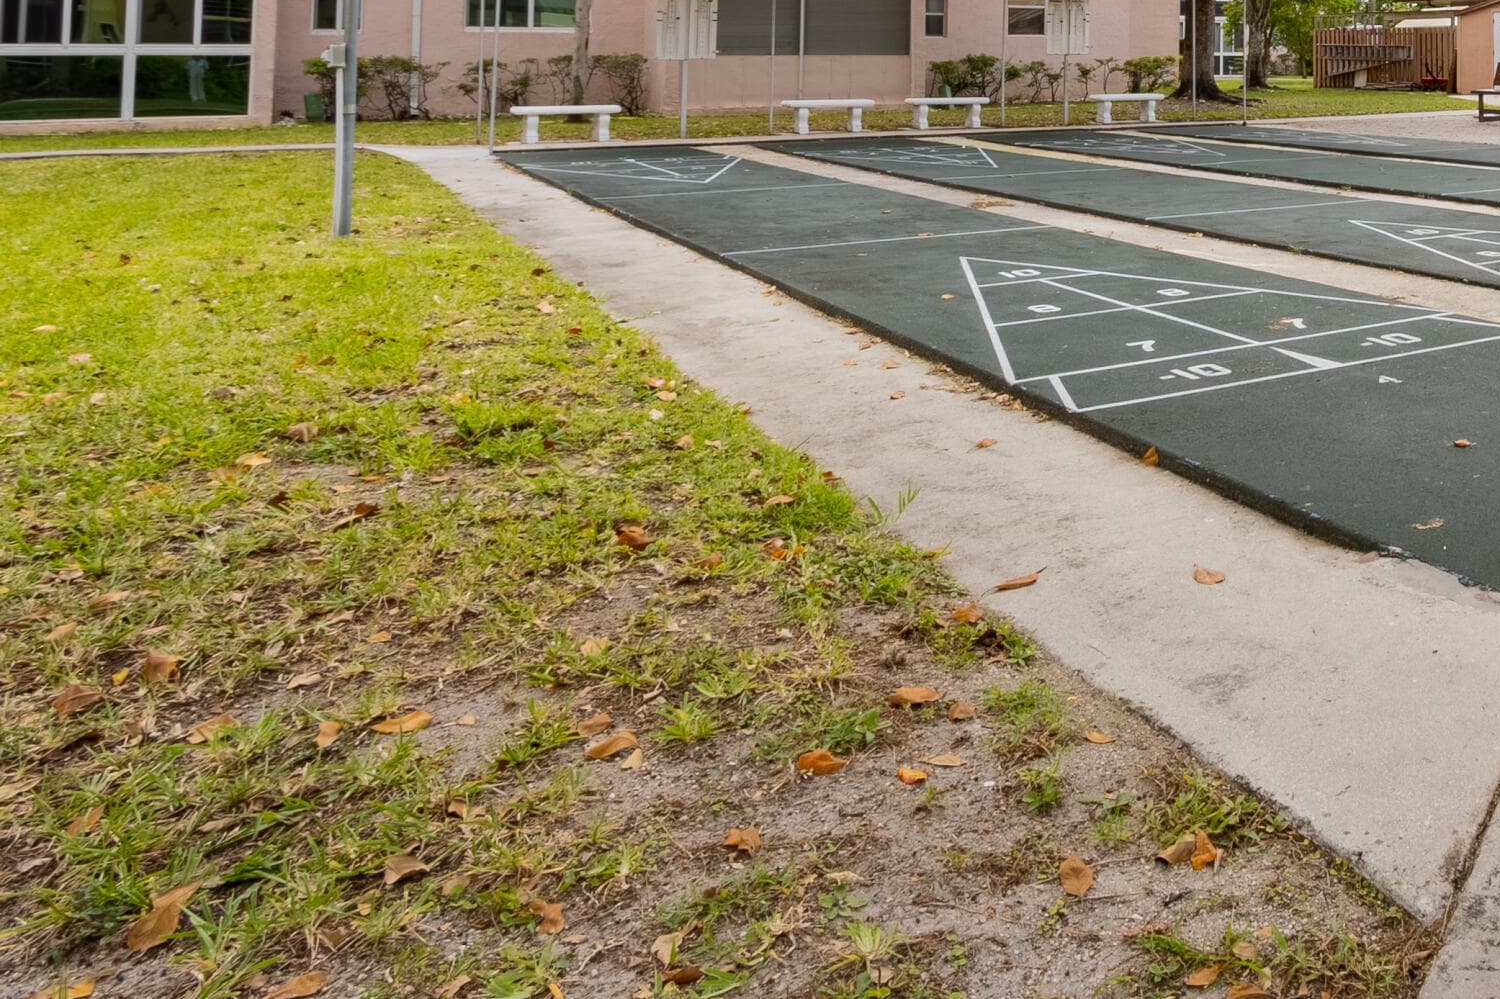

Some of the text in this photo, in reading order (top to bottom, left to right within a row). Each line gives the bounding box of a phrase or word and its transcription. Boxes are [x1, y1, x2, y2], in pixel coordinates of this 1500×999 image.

[998, 268, 1042, 279] 10
[1125, 340, 1156, 352] 7
[1159, 363, 1232, 380] -10
